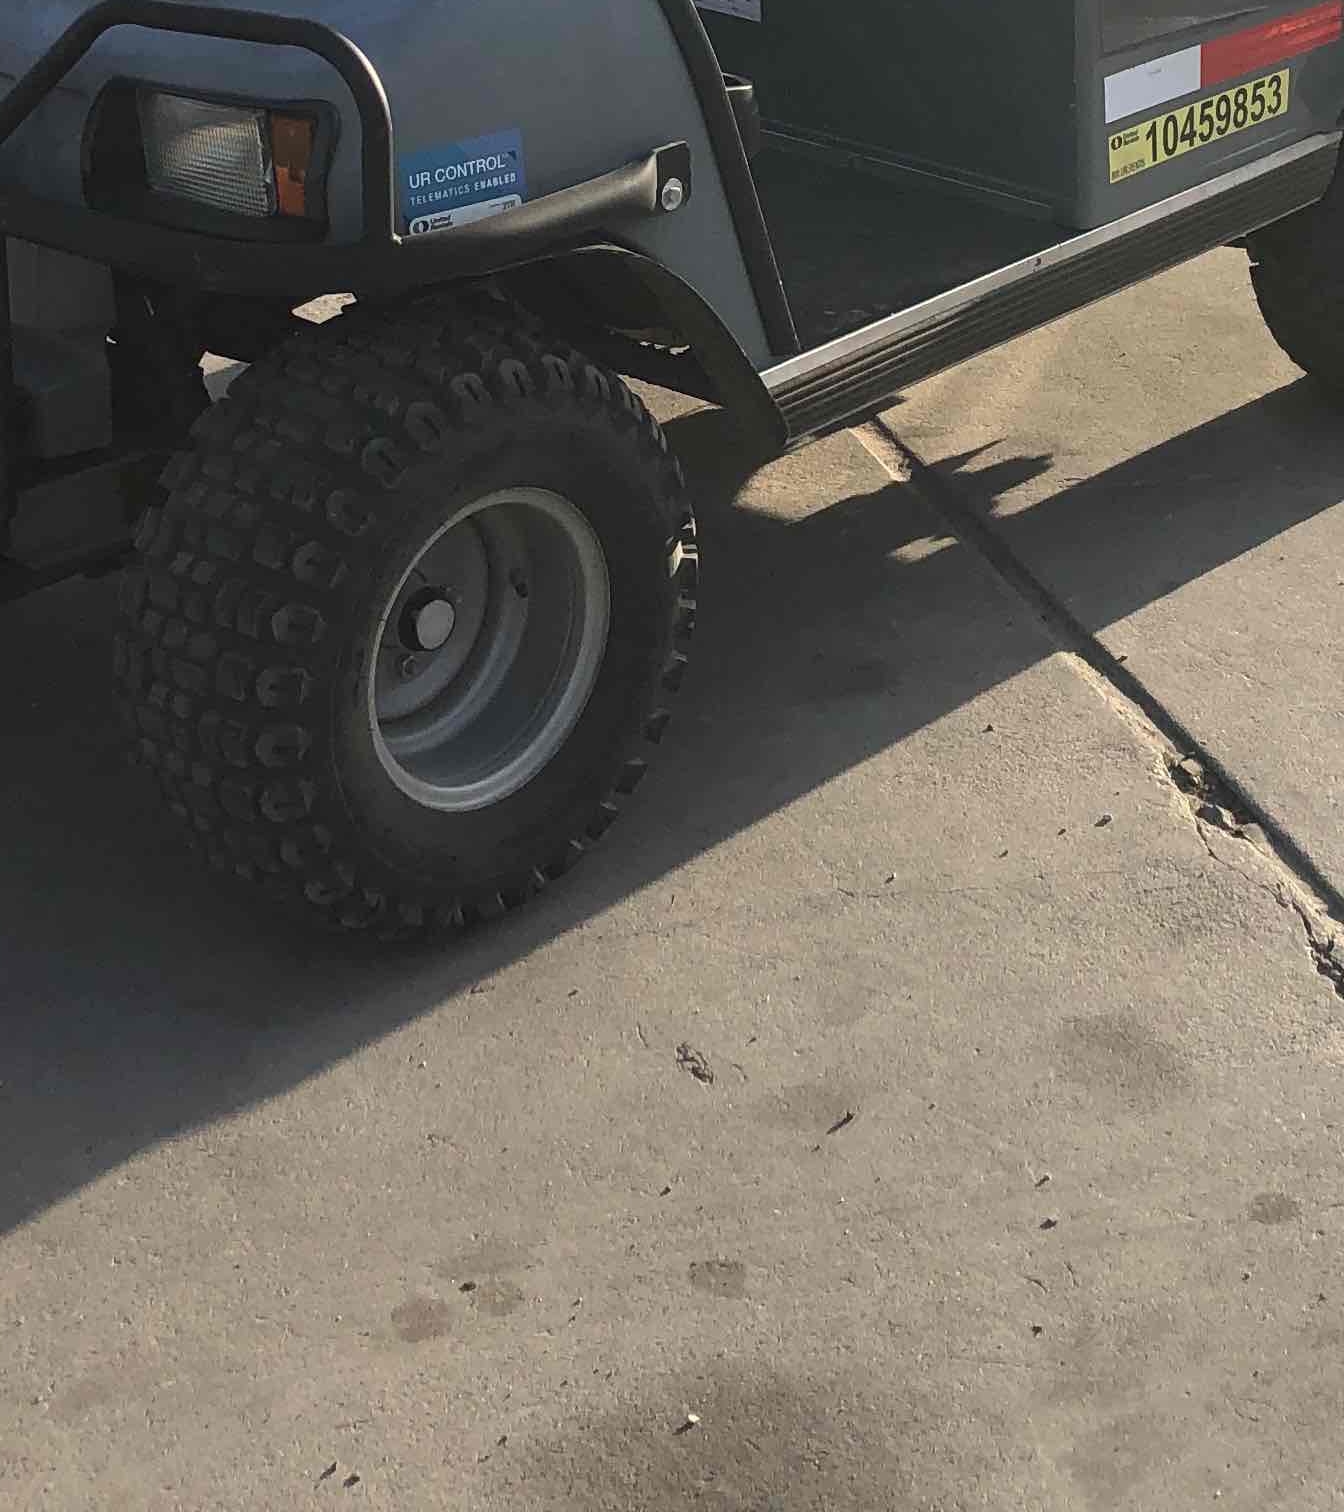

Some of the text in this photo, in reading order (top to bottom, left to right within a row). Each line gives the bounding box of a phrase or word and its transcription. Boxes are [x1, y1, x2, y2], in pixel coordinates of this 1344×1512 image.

[1145, 74, 1284, 162] 10459853
[409, 154, 506, 189] UR CONTROL
[409, 172, 517, 207] TELEMATICS ENABLED
